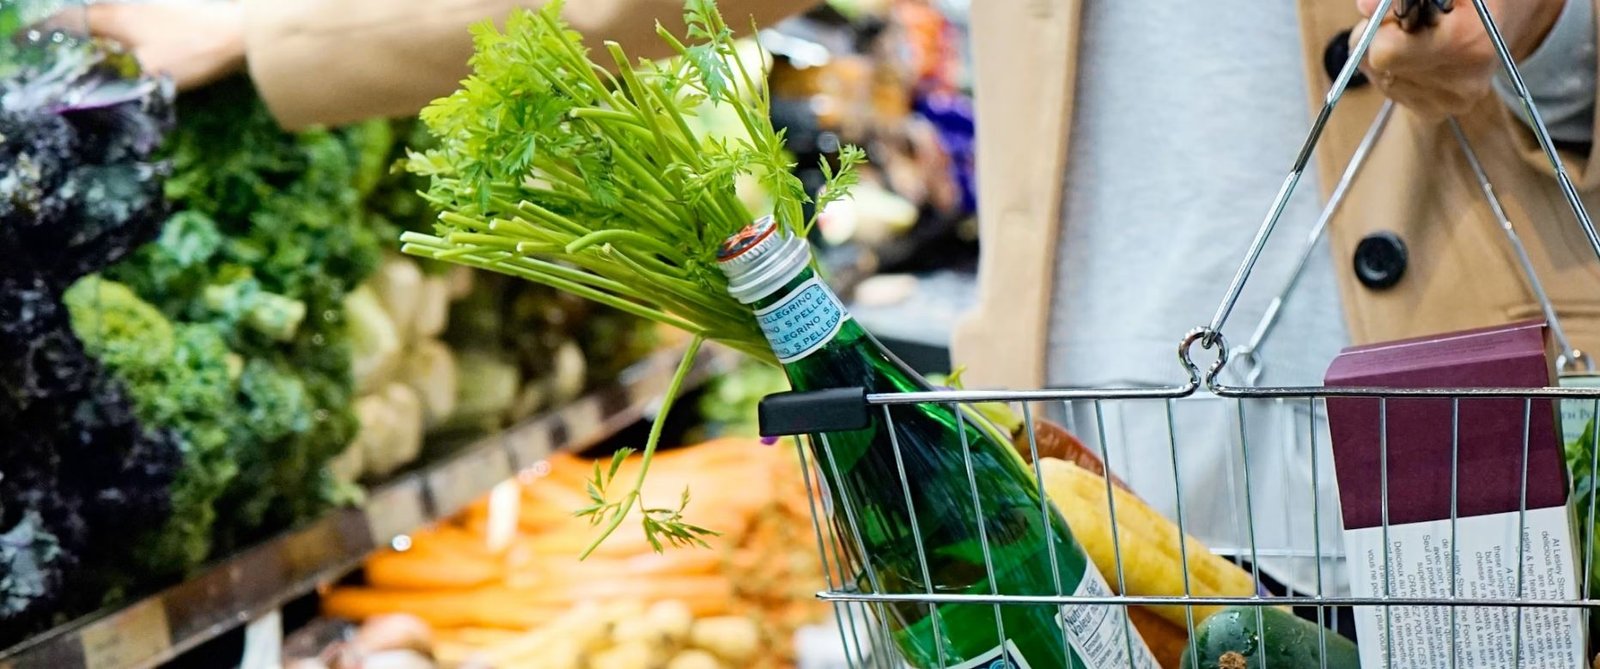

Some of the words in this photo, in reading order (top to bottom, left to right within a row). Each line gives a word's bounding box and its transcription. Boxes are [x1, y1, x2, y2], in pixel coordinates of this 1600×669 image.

[1423, 534, 1432, 553] Seul
[1442, 538, 1449, 549] de
[1542, 531, 1553, 566] delicious
[1552, 538, 1560, 547] At
[1367, 549, 1376, 569] vous
[1394, 541, 1405, 577] Délicieux
[1426, 555, 1432, 565] un
[1476, 552, 1485, 581] cheese
[1485, 551, 1493, 564] but
[1493, 545, 1503, 568] these
[1552, 549, 1564, 575] Lesley
[1371, 570, 1377, 581] ne
[1427, 567, 1437, 595] produit
[1485, 566, 1496, 588] really
[1527, 563, 1536, 577] her
[1399, 579, 1405, 590] au
[1433, 546, 1441, 566] avec
[1441, 606, 1450, 627] etites
[1480, 583, 1486, 591] or
[1496, 570, 1507, 597] unique
[1507, 576, 1518, 602] CRIS
[1529, 579, 1537, 600] team
[1371, 582, 1381, 613] pouz
[1408, 574, 1420, 618] CRAEZ
[1417, 562, 1428, 598] supérieu
[1423, 606, 1432, 635] pouvait
[1539, 590, 1548, 612] mae
[1550, 590, 1559, 614] The
[1395, 613, 1401, 624] de
[1456, 578, 1466, 598] Stow
[1462, 624, 1473, 649] Foods
[1470, 581, 1478, 599] snac
[1479, 649, 1487, 667] sure
[1493, 613, 1501, 634] when
[1501, 605, 1511, 633] ackers
[1543, 614, 1551, 631] with
[1414, 619, 1424, 646] POUR
[1486, 632, 1495, 646] We
[1524, 613, 1534, 642] scratch
[1553, 616, 1564, 649] fabulous
[1563, 624, 1573, 649] Foods
[1435, 627, 1446, 659] fabriqué
[1495, 635, 1506, 663] topped
[1535, 637, 1545, 654] only
[1545, 632, 1553, 650] care
[1407, 639, 1417, 669] craquel
[1417, 646, 1427, 666] CES
[1506, 649, 1515, 669] grea
[1526, 643, 1536, 665] using
